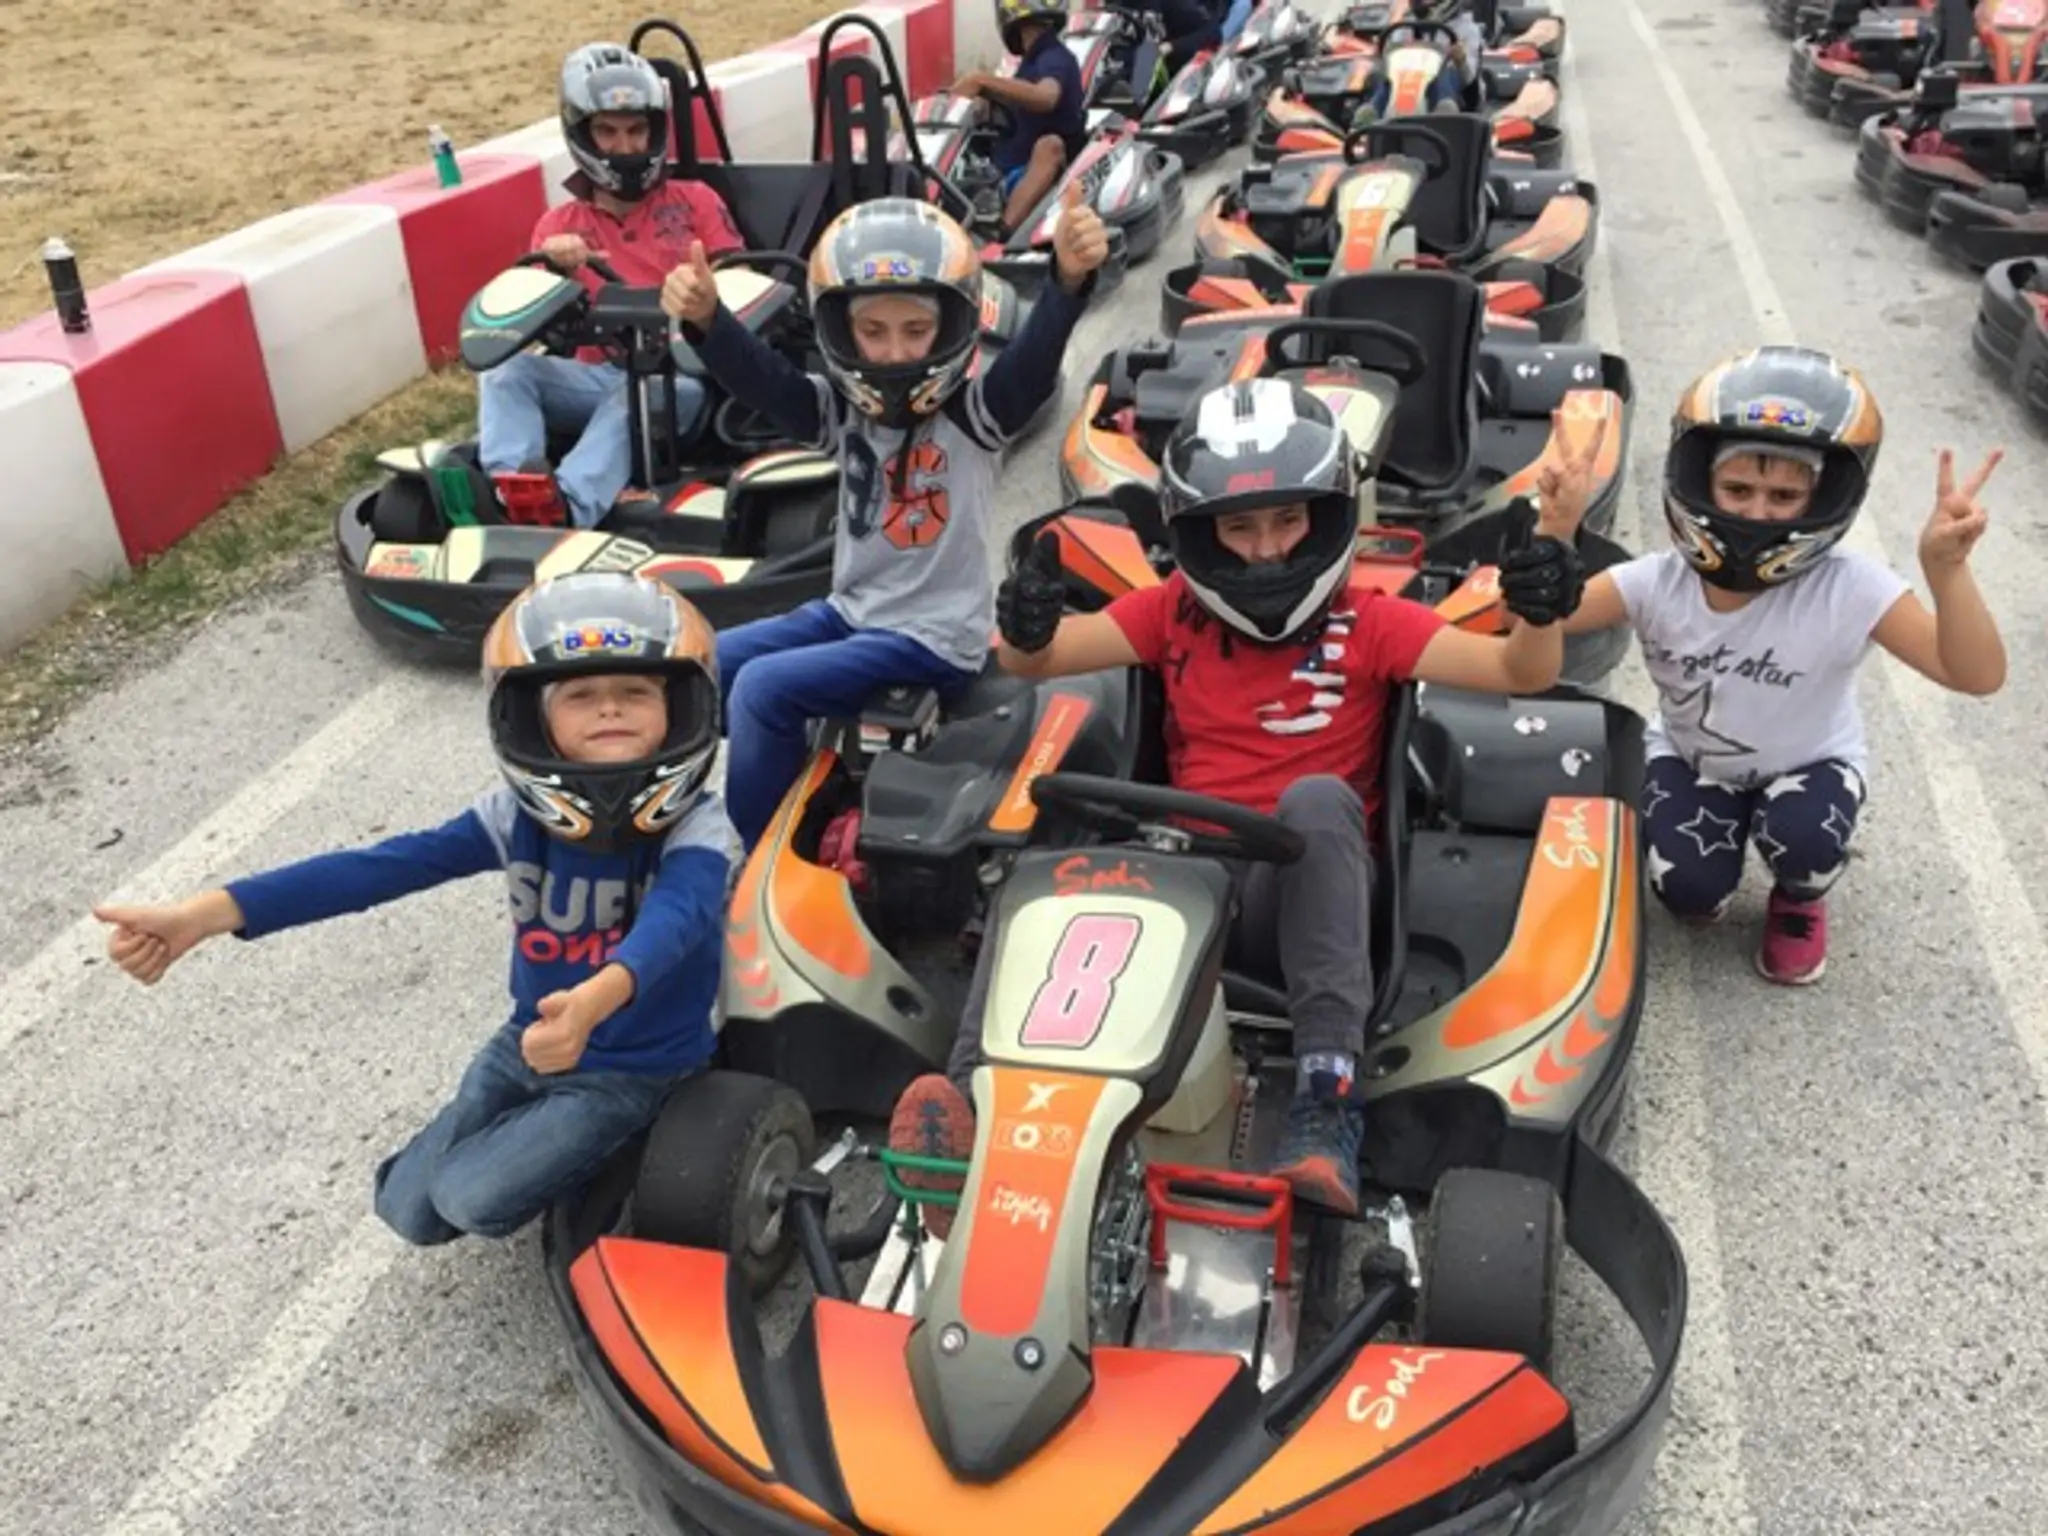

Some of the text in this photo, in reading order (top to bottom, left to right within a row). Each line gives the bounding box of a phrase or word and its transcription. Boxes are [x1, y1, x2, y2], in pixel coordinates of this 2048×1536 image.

[1681, 643, 1737, 680] got
[1734, 648, 1805, 689] star
[1018, 911, 1144, 1051] 8
[1346, 1347, 1446, 1432] Sodi
